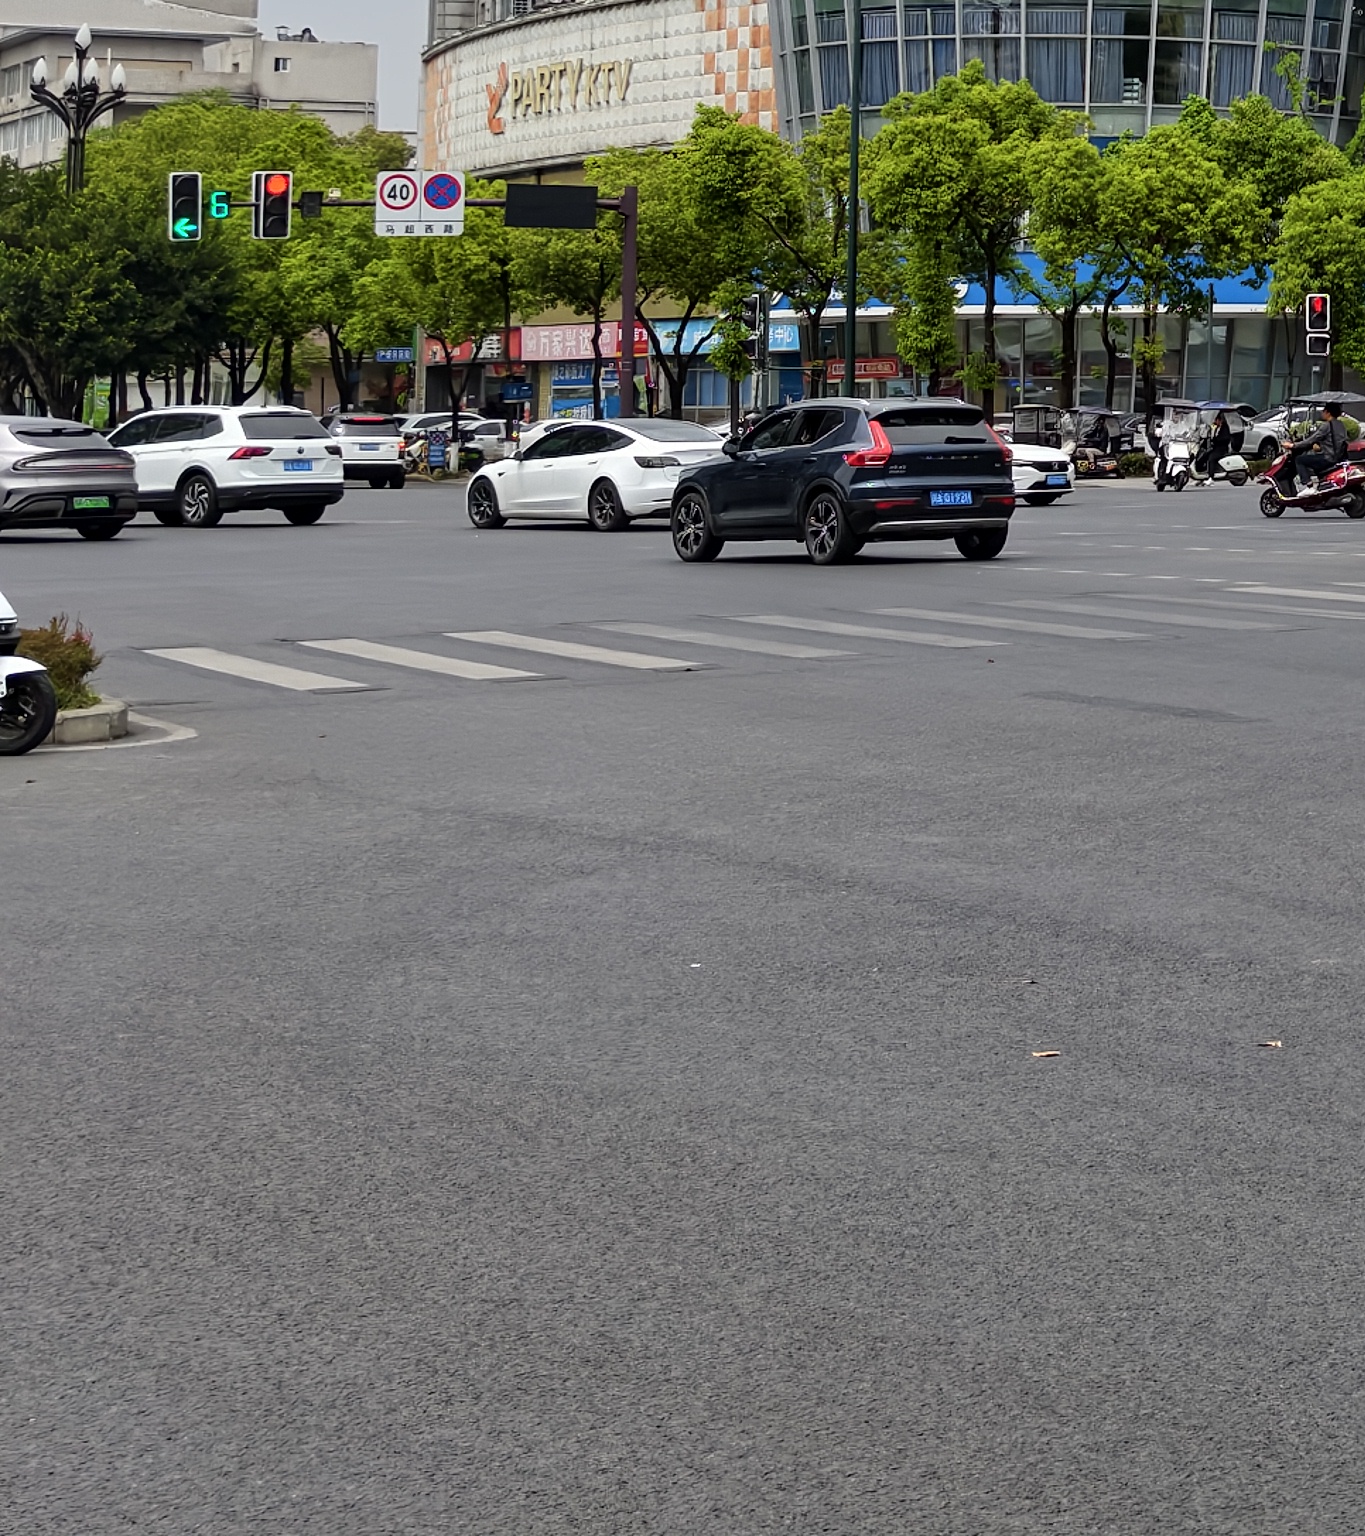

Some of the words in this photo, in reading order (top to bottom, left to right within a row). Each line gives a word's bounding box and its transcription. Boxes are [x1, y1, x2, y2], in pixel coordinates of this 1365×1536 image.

[512, 57, 583, 120] PARTY
[584, 58, 633, 106] KTV
[210, 192, 231, 219] 6
[387, 184, 410, 201] 40
